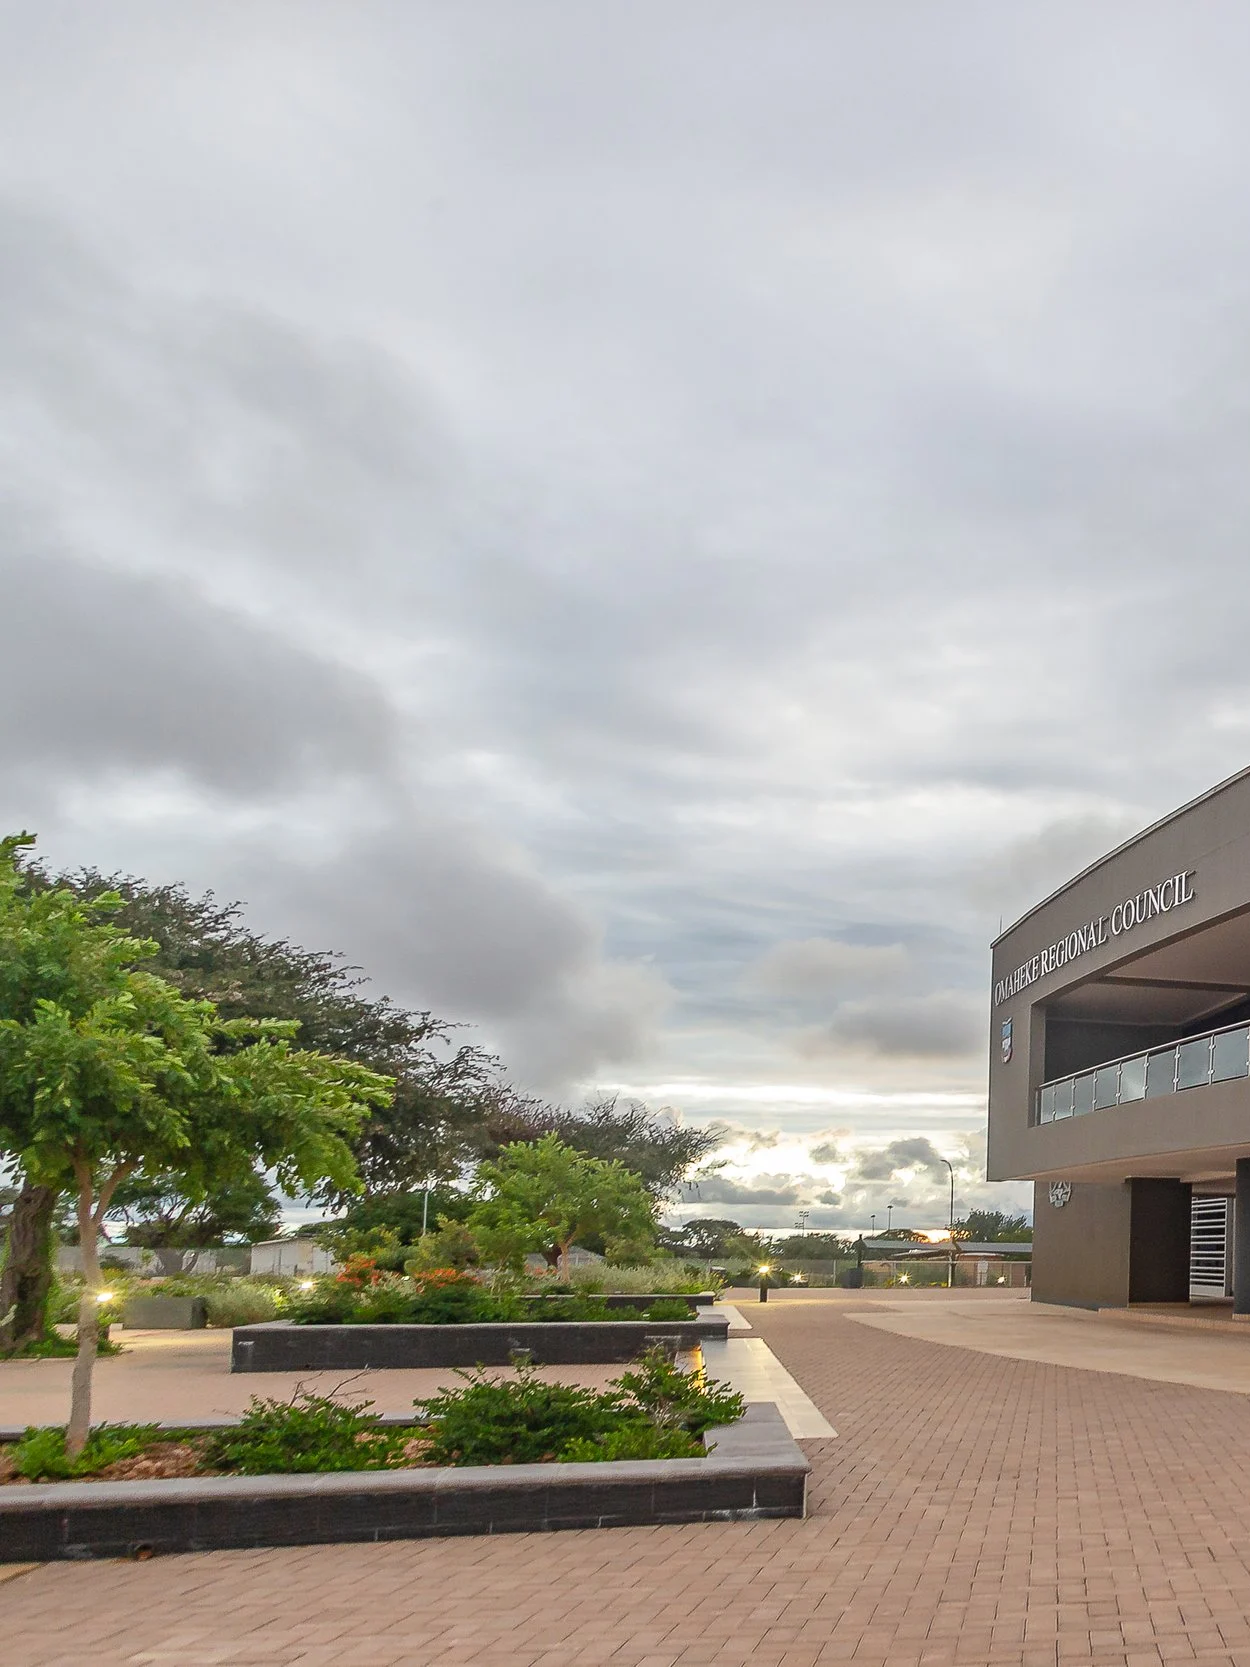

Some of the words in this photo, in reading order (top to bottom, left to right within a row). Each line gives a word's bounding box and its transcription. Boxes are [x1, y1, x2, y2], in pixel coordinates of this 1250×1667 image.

[994, 955, 1040, 1007] OMAHEKE
[1040, 915, 1107, 977] REGIONAL
[1110, 870, 1196, 936] COUNCIL
